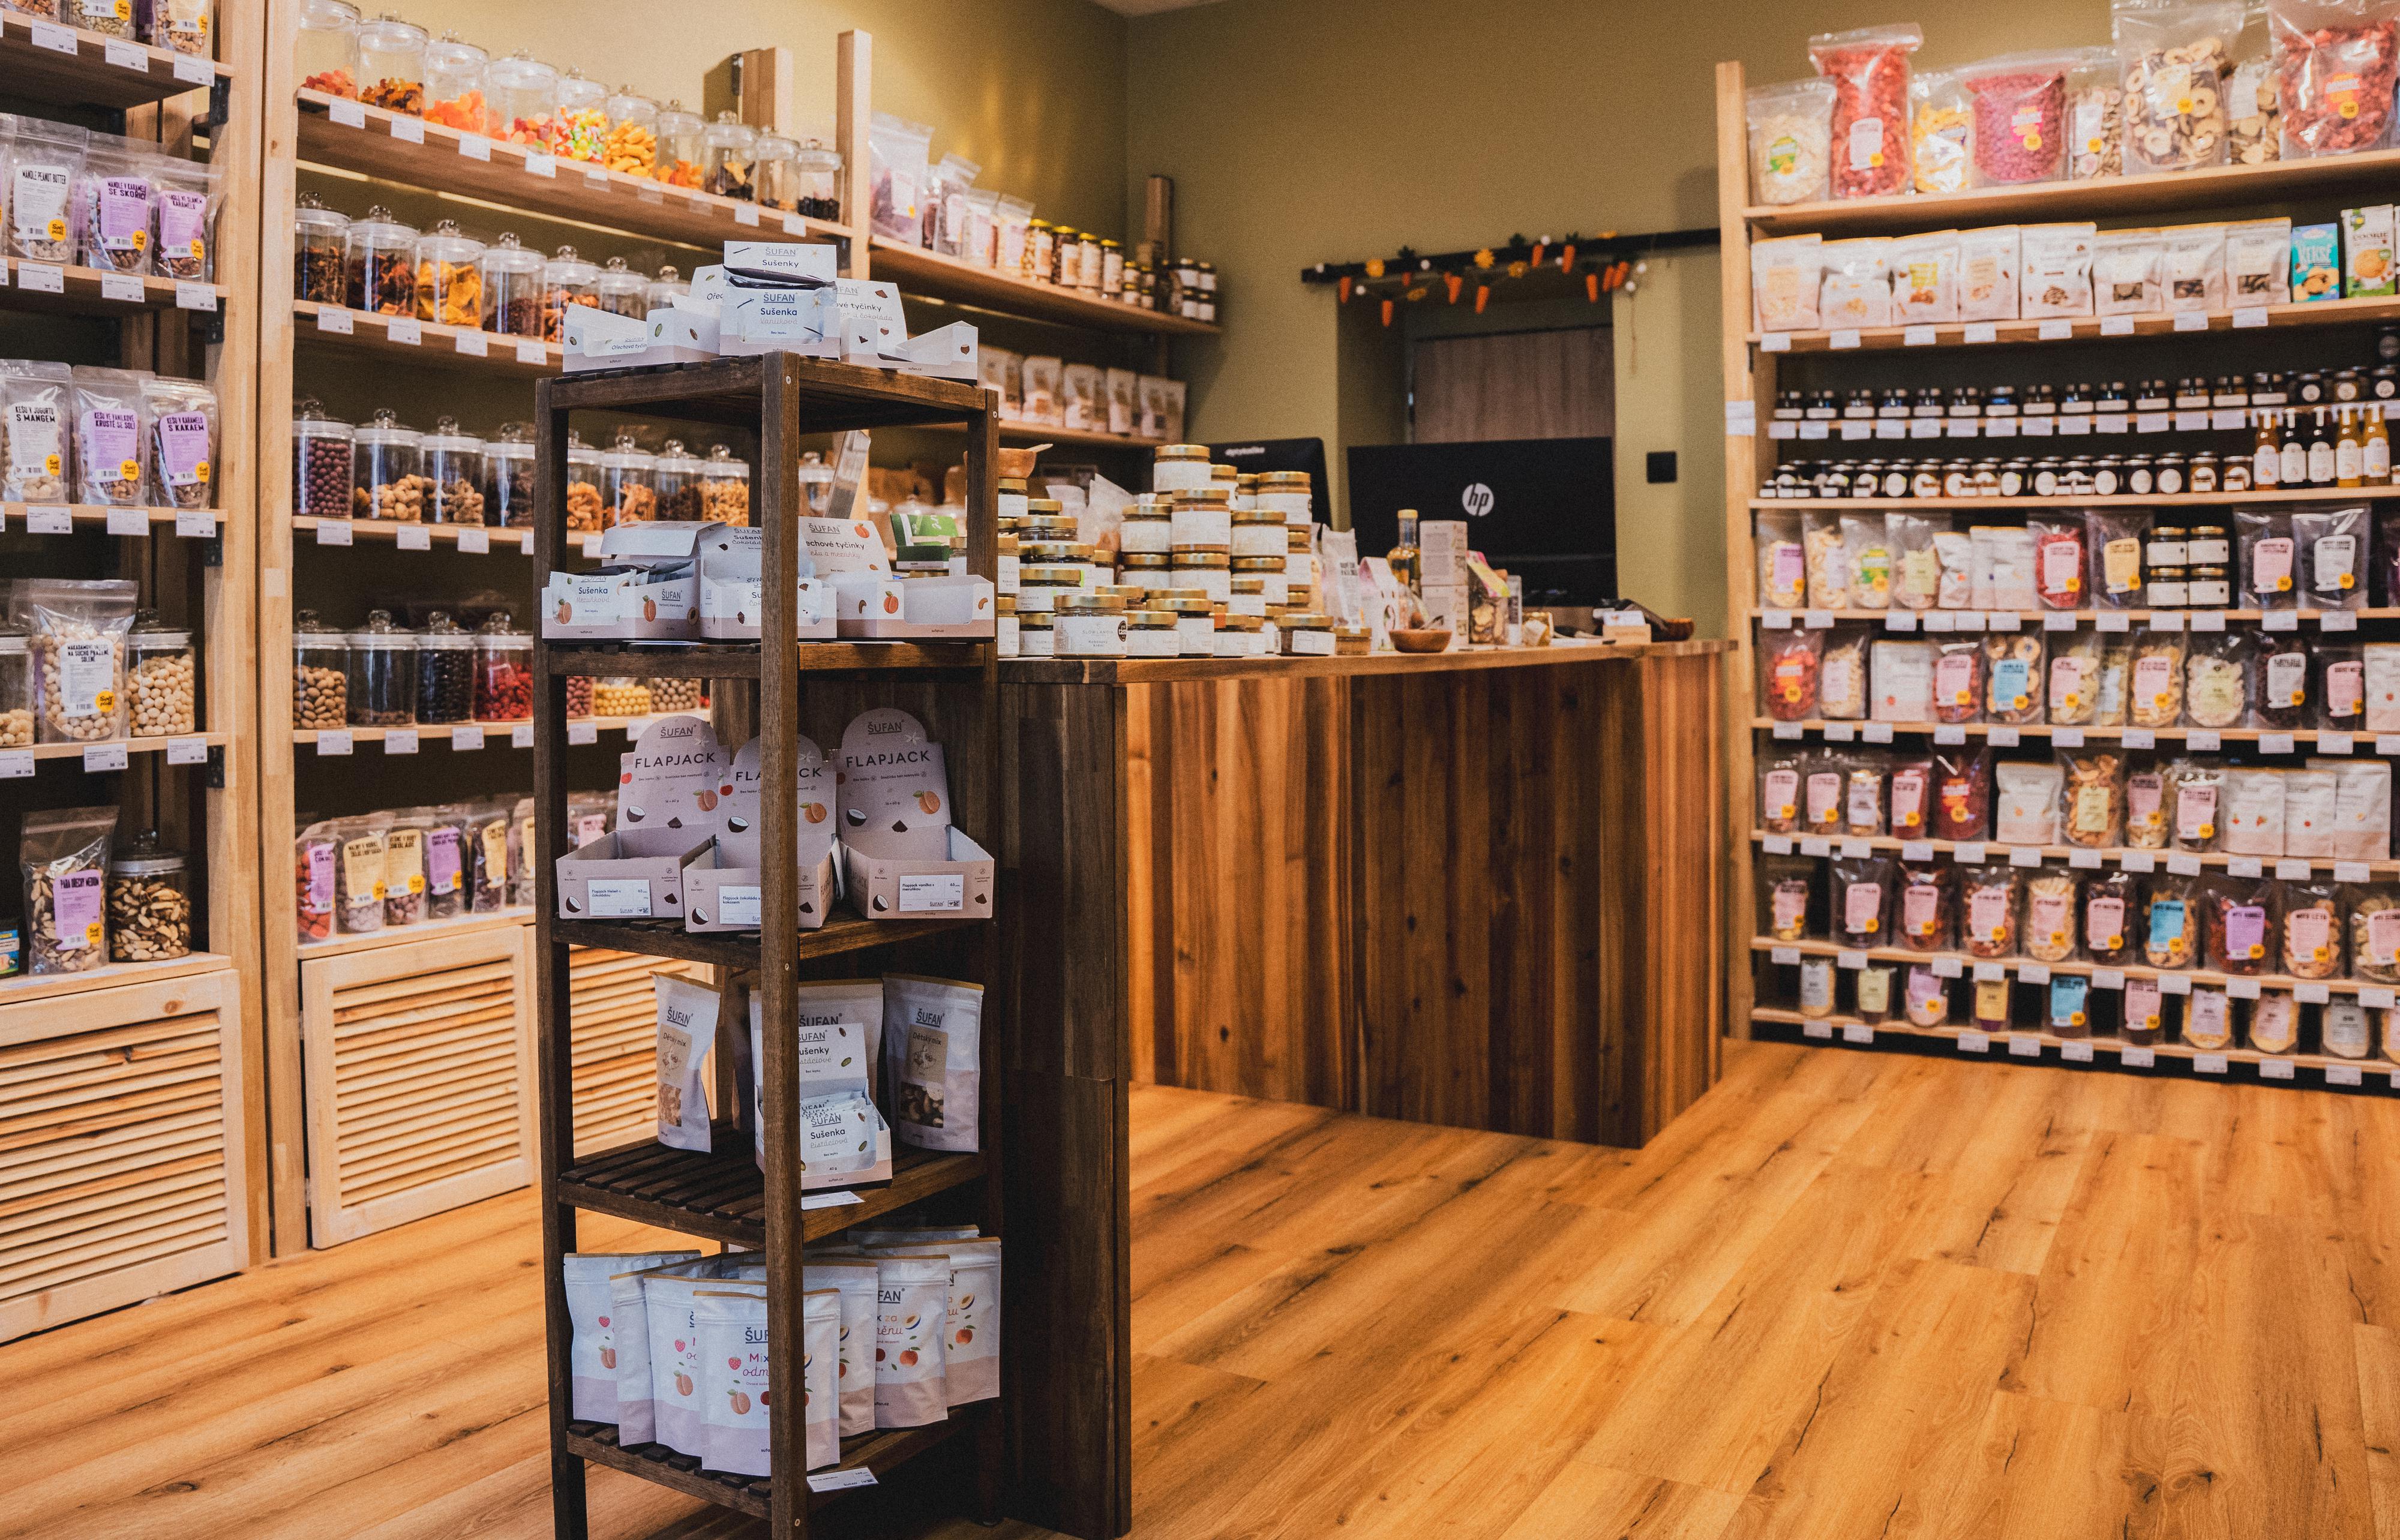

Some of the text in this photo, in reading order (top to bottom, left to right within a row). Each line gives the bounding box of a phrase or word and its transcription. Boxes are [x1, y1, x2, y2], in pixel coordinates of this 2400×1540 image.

[766, 247, 796, 255] ŠUFAN
[763, 292, 795, 302] ŠUFAN
[851, 303, 881, 312] tyčinky
[1468, 483, 1489, 516] hp
[809, 523, 839, 533] ŠUFAN
[662, 589, 680, 599] ŠUFAN
[868, 721, 902, 732] ŠUFAN
[661, 727, 693, 737] ŠUFAN
[635, 752, 716, 769] FLAPJACK
[846, 750, 931, 767] FLAPJACK
[667, 1006, 691, 1025] ŠUFAN
[799, 1015, 839, 1026] ŠUFAN
[917, 1008, 942, 1025] ŠUFAN
[799, 1046, 829, 1055] ušenky
[800, 1056, 831, 1064] stáciové
[811, 1128, 845, 1139] Sušenka
[878, 1290, 901, 1301] FAN
[745, 1326, 769, 1341] ŠUF
[749, 1353, 769, 1362] Mix
[743, 1366, 769, 1376] odm
